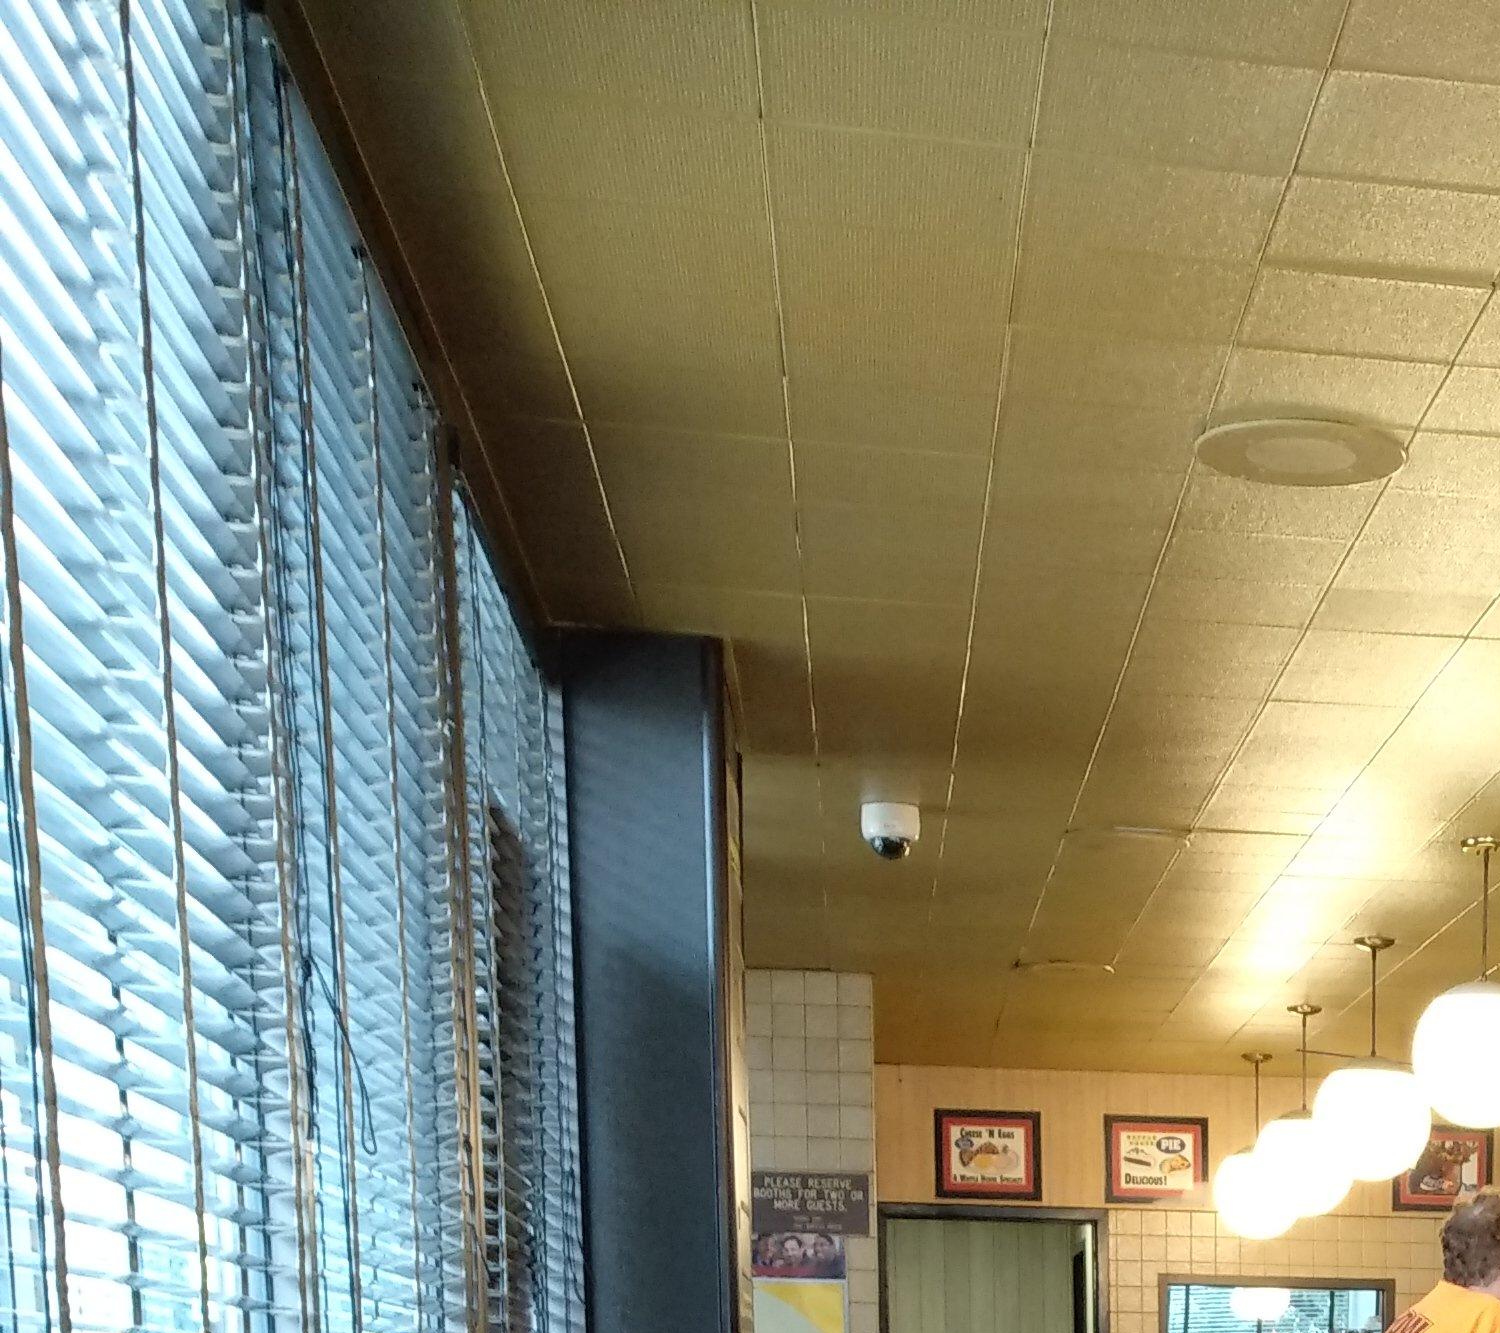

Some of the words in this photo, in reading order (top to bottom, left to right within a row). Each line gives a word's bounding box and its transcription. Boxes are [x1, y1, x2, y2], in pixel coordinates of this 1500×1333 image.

[1160, 1139, 1181, 1150] PIE
[764, 1175, 802, 1189] PLEASE
[808, 1177, 852, 1190] RESERVE
[1125, 1173, 1167, 1186] DELICIOUS!
[754, 1187, 792, 1199] BOOTHS
[798, 1189, 818, 1199] FOR
[824, 1189, 846, 1200] TWO
[850, 1190, 864, 1202] OR
[773, 1199, 801, 1211] MORE
